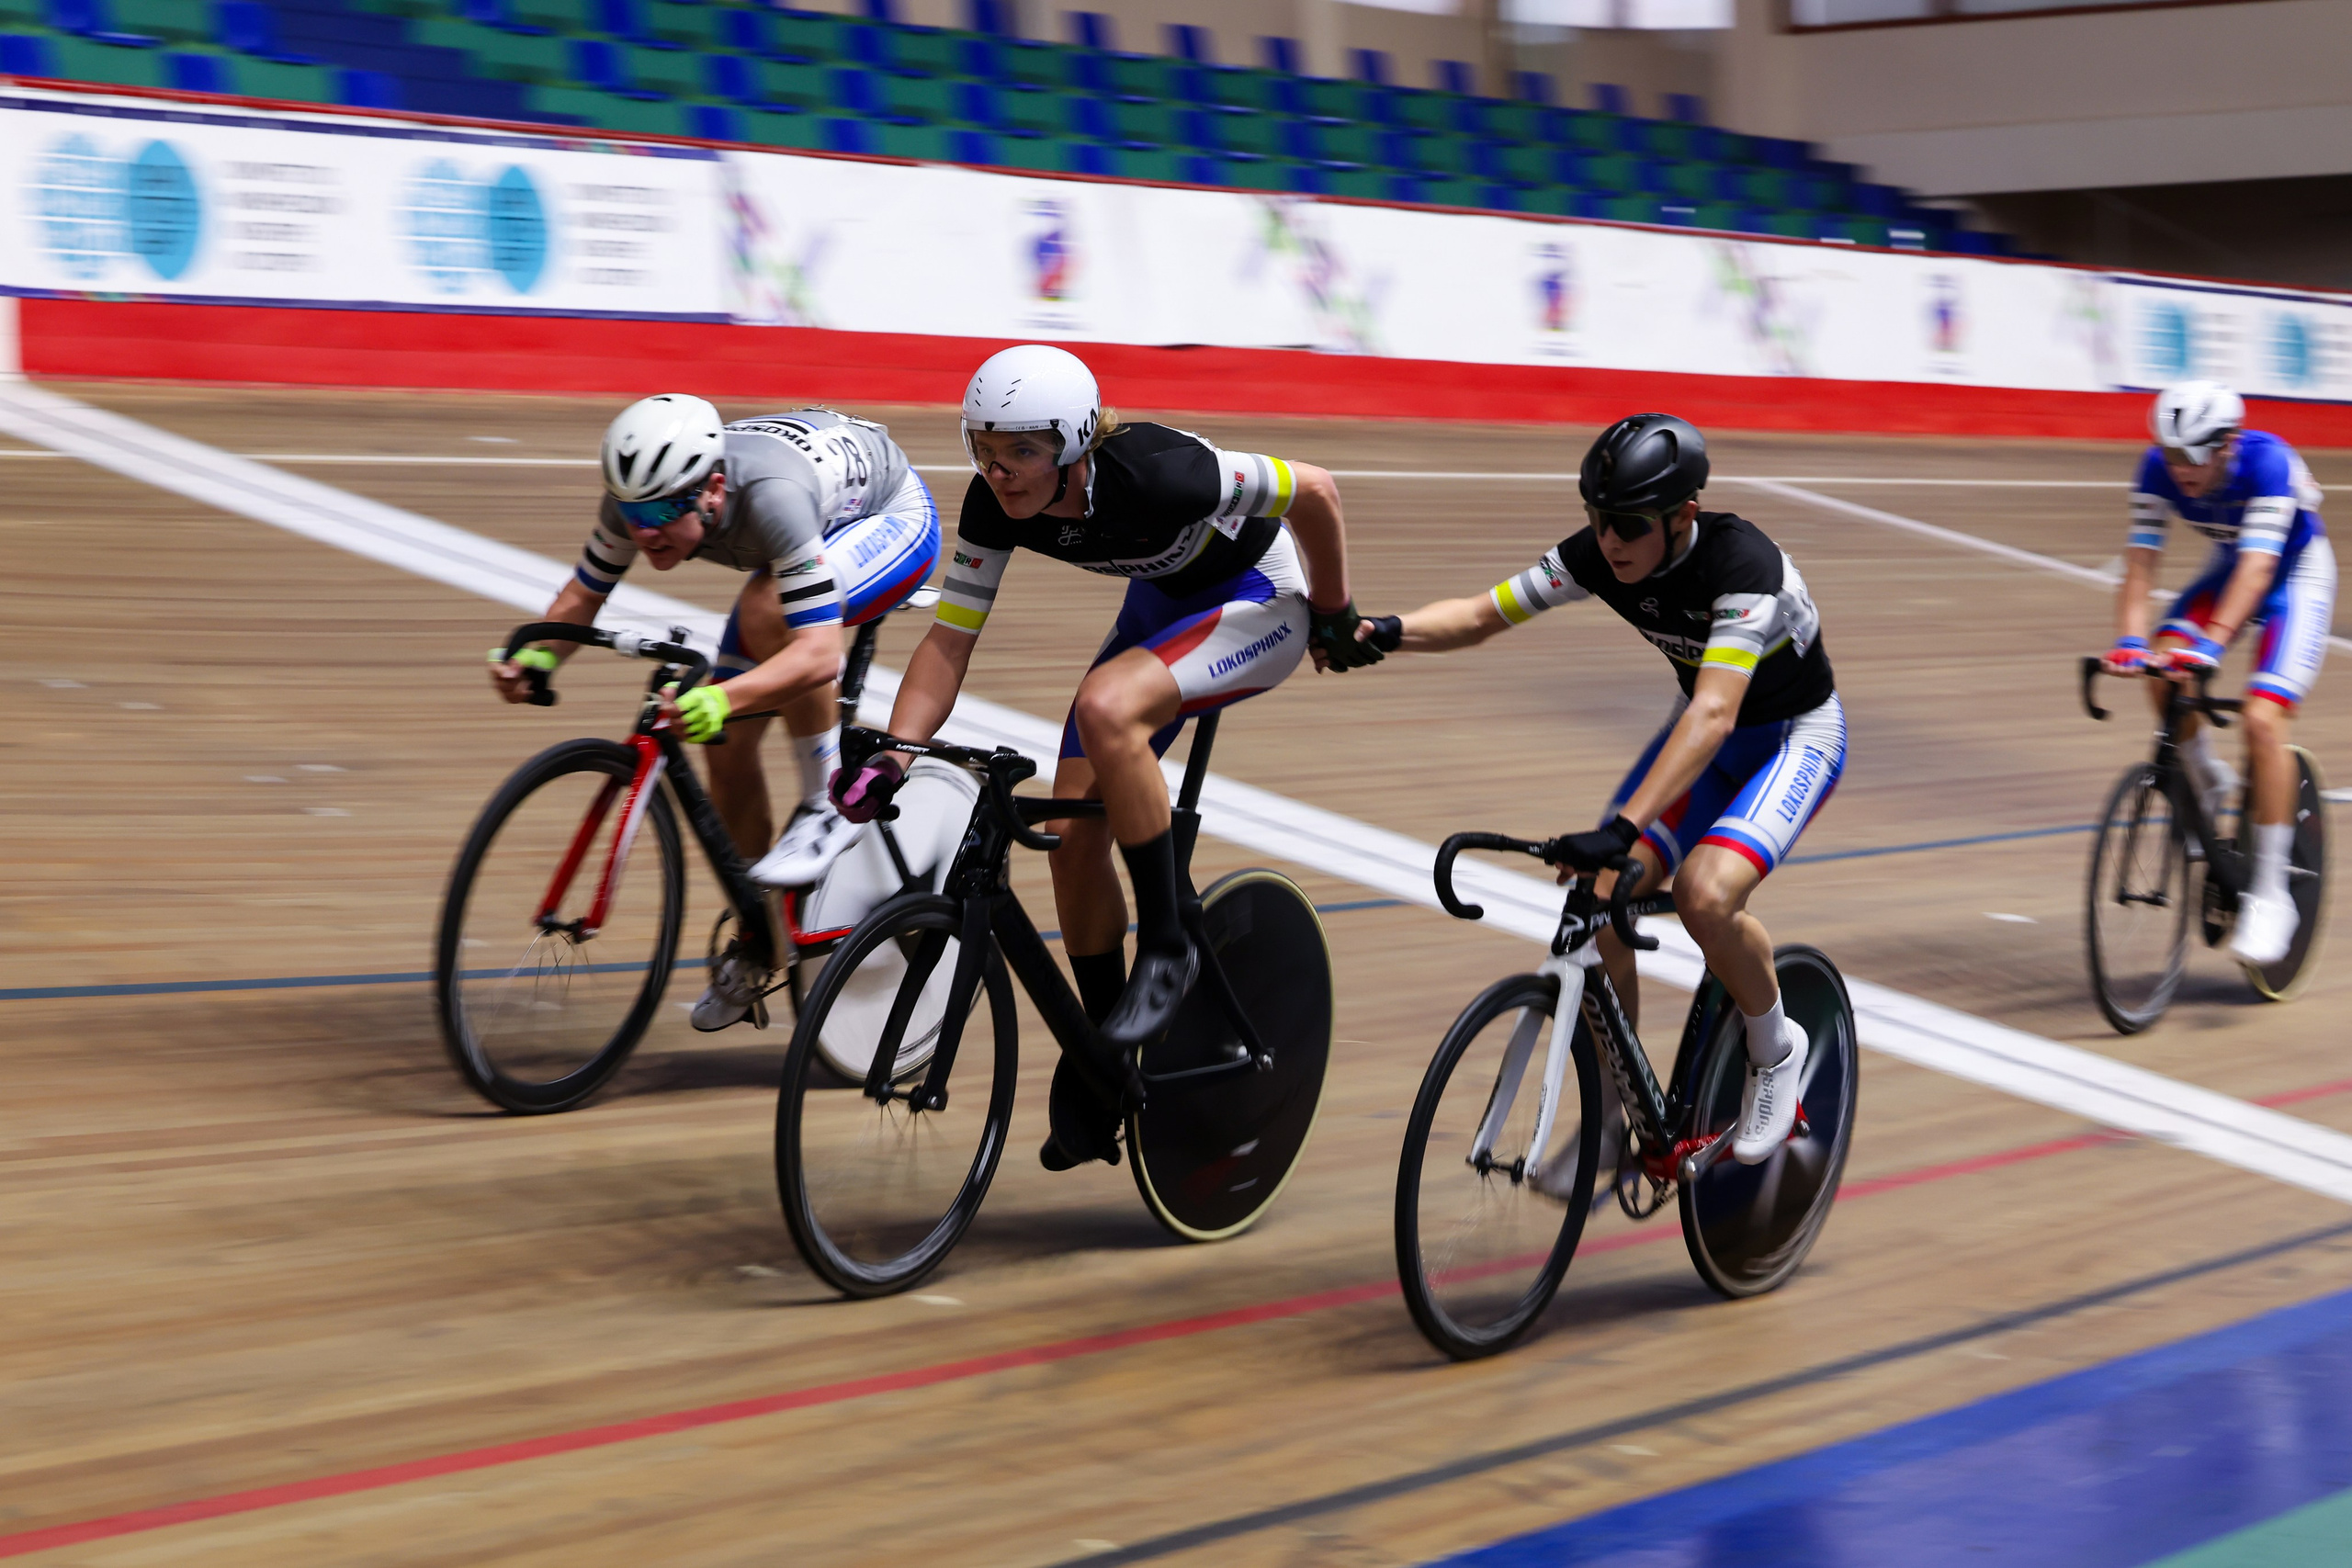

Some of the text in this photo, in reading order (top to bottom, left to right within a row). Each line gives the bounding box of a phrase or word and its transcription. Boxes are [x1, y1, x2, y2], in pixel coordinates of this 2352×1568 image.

[826, 436, 867, 489] 28
[1208, 621, 1293, 680] LOKOSPHINX
[1776, 744, 1825, 824] LOKOSPHINX
[1589, 900, 1657, 932] PINELLO
[1603, 972, 1666, 1121] PINARELLO
